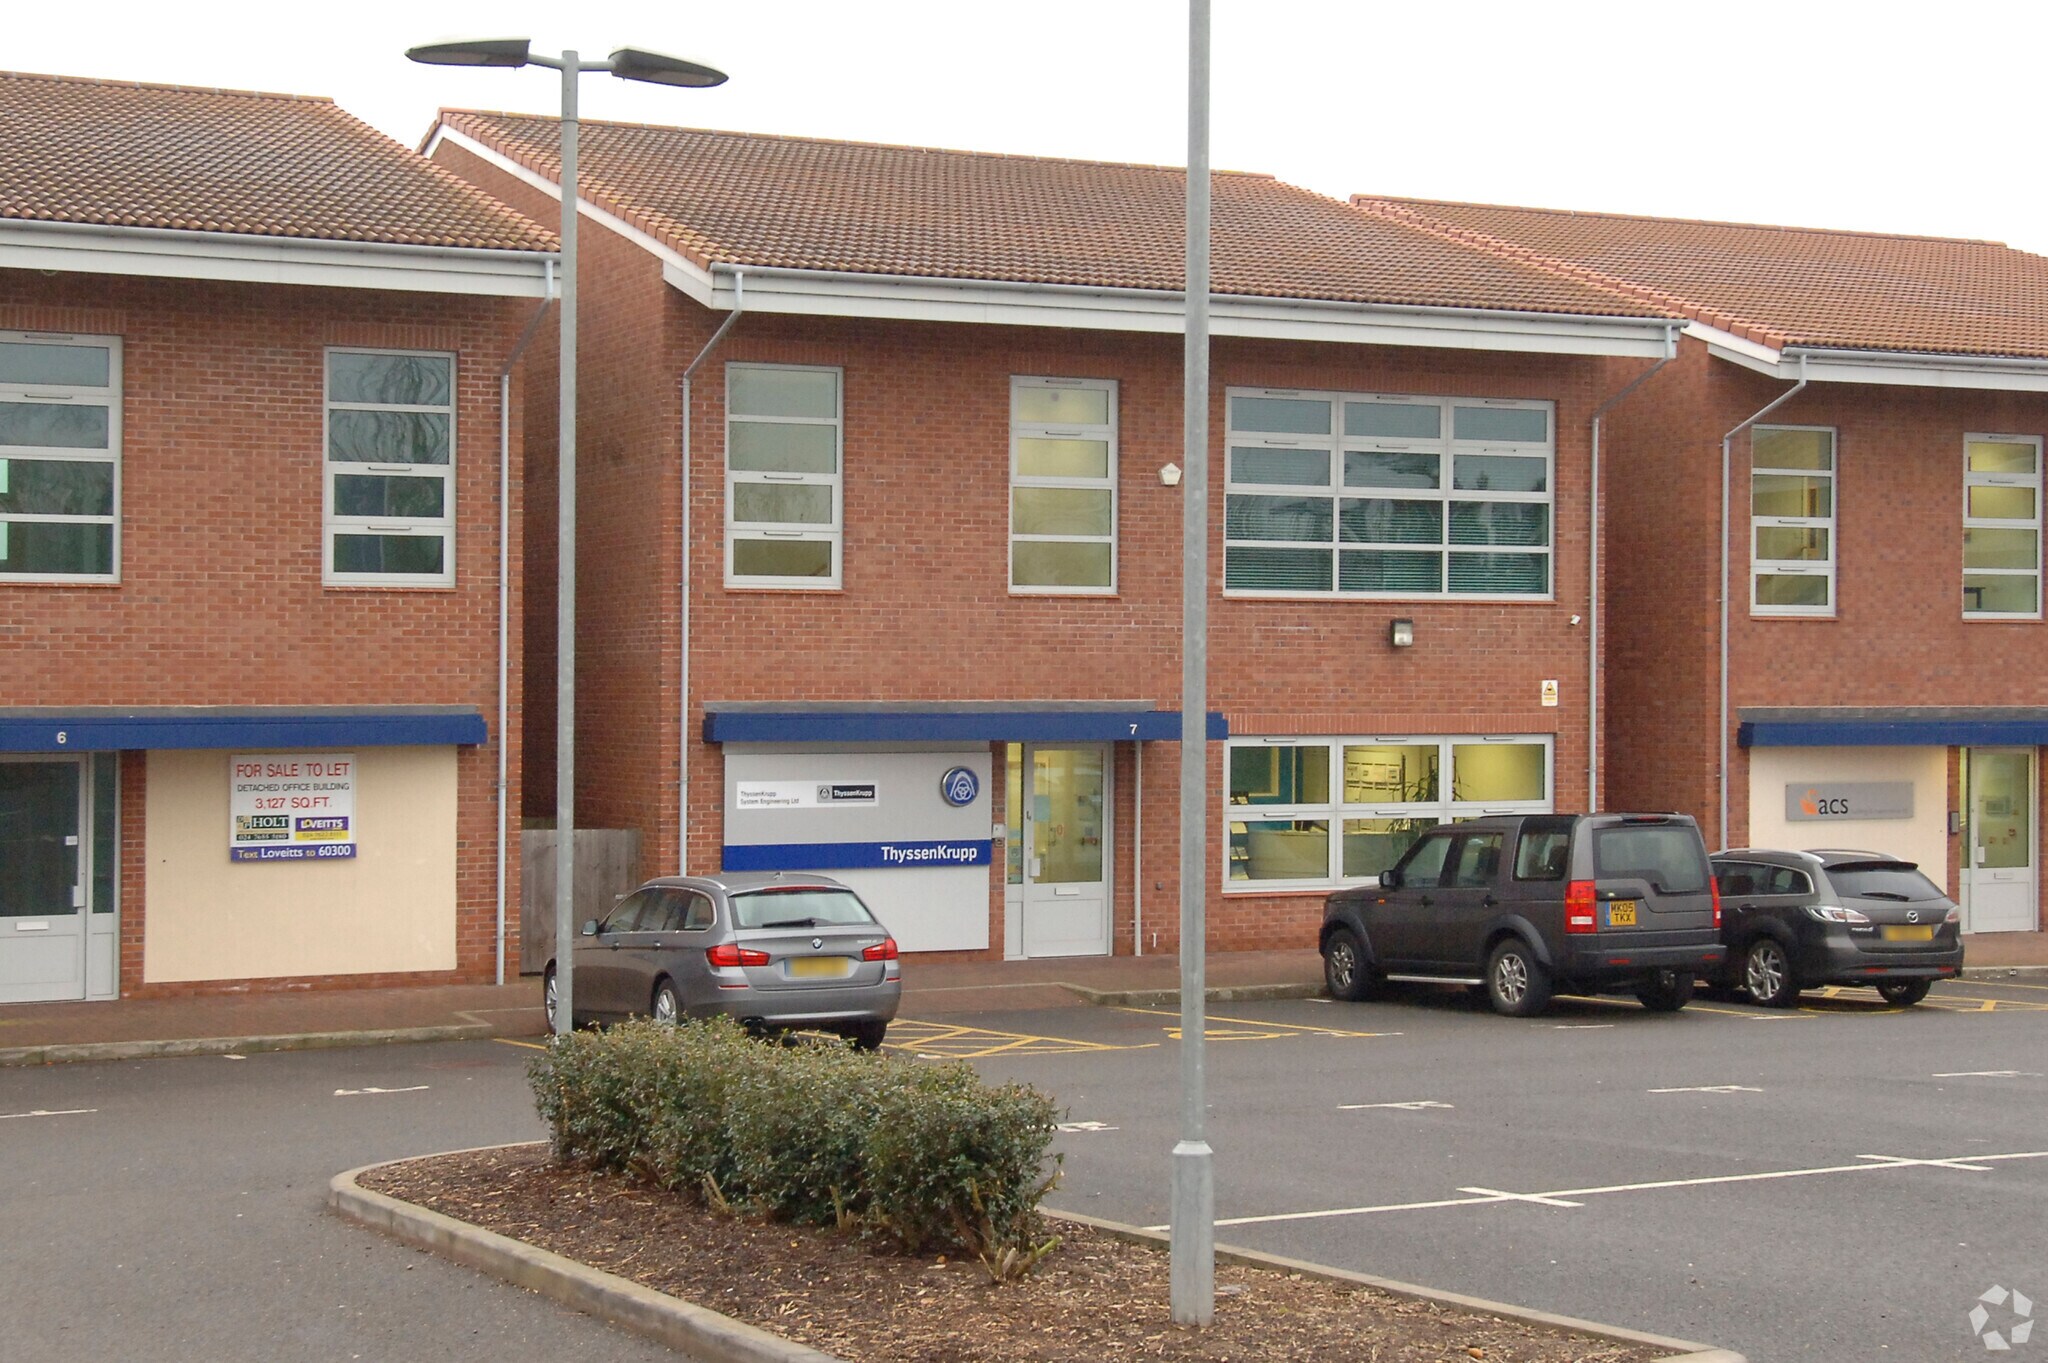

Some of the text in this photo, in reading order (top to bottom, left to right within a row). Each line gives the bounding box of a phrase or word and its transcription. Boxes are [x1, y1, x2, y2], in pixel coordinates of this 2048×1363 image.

[1129, 724, 1138, 735] 7
[57, 731, 67, 744] 6
[236, 762, 350, 778] FOR SALE TO LET
[237, 782, 350, 792] DETACHED OFFICE BUILDING
[255, 797, 286, 810] 3,127
[1818, 798, 1849, 815] acs
[253, 816, 289, 828] HOLT
[300, 818, 344, 829] LOVEITTS
[238, 845, 351, 859] Text Loveitts to 60300
[881, 844, 978, 864] ThyssenKrupp
[1610, 902, 1634, 913] MK05
[1614, 912, 1632, 923] TKX
